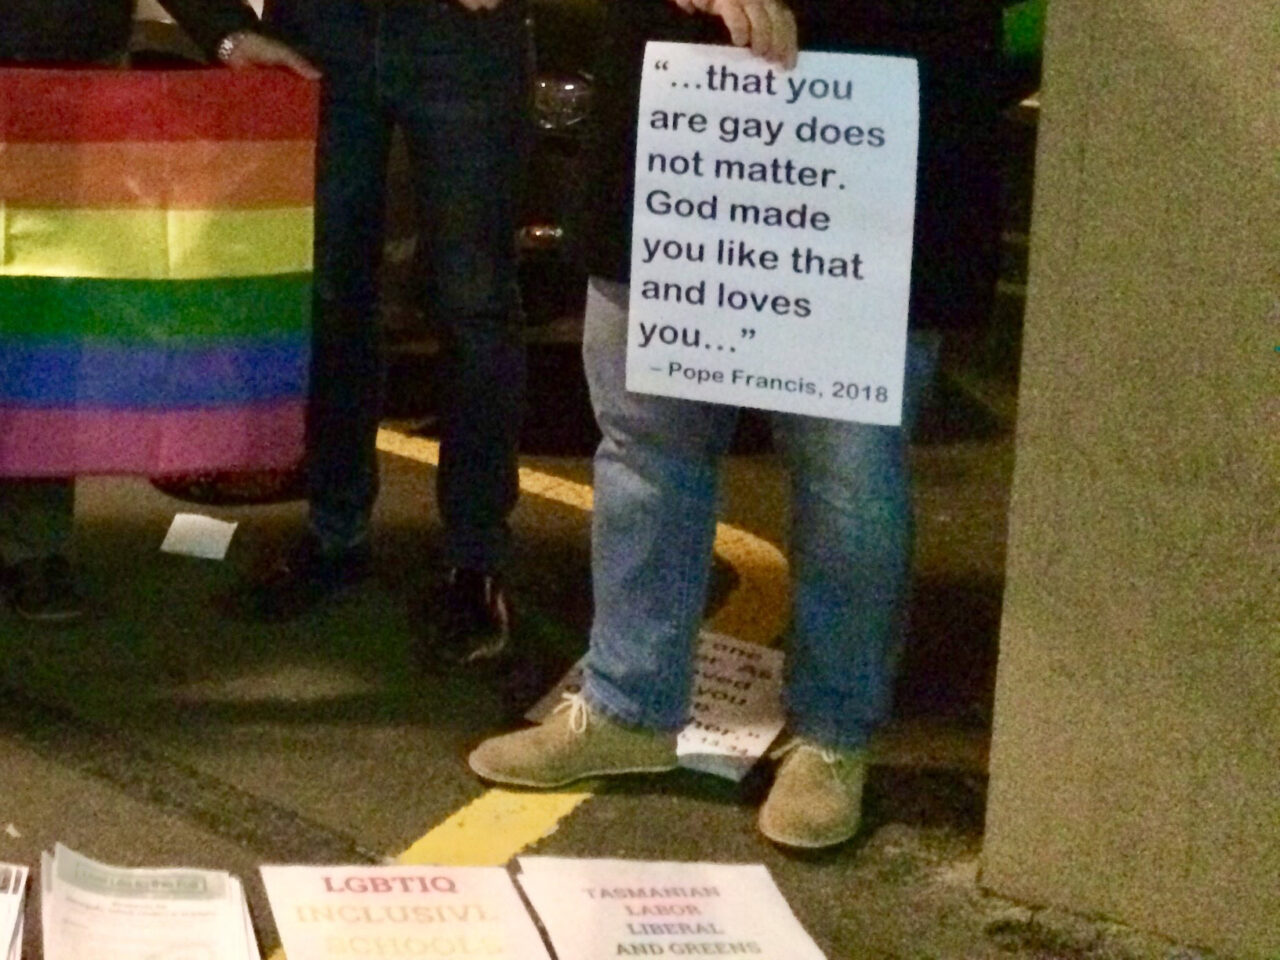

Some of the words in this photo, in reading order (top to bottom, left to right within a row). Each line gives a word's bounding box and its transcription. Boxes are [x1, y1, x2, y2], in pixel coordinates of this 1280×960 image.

[785, 76, 853, 104] you
[650, 110, 708, 132] are
[719, 117, 783, 146] gay
[796, 117, 885, 147] does
[648, 151, 704, 176] not
[715, 157, 846, 190] matter.
[646, 190, 717, 219] God
[730, 202, 831, 231] made
[642, 237, 704, 263] you
[717, 239, 779, 269] like
[792, 247, 864, 280] that
[642, 279, 705, 305] and
[718, 283, 812, 318] loves
[669, 363, 724, 385] Pope
[732, 370, 823, 398] Francis,
[832, 382, 889, 403] 2018
[322, 876, 458, 893] LGBTIQ
[582, 886, 721, 900] TASMANIAN
[295, 904, 498, 923] INCLUSIVE
[624, 904, 702, 916] LABOR
[627, 922, 724, 935] LIBERAL
[616, 942, 666, 955] AND
[670, 942, 762, 955] GREENS
